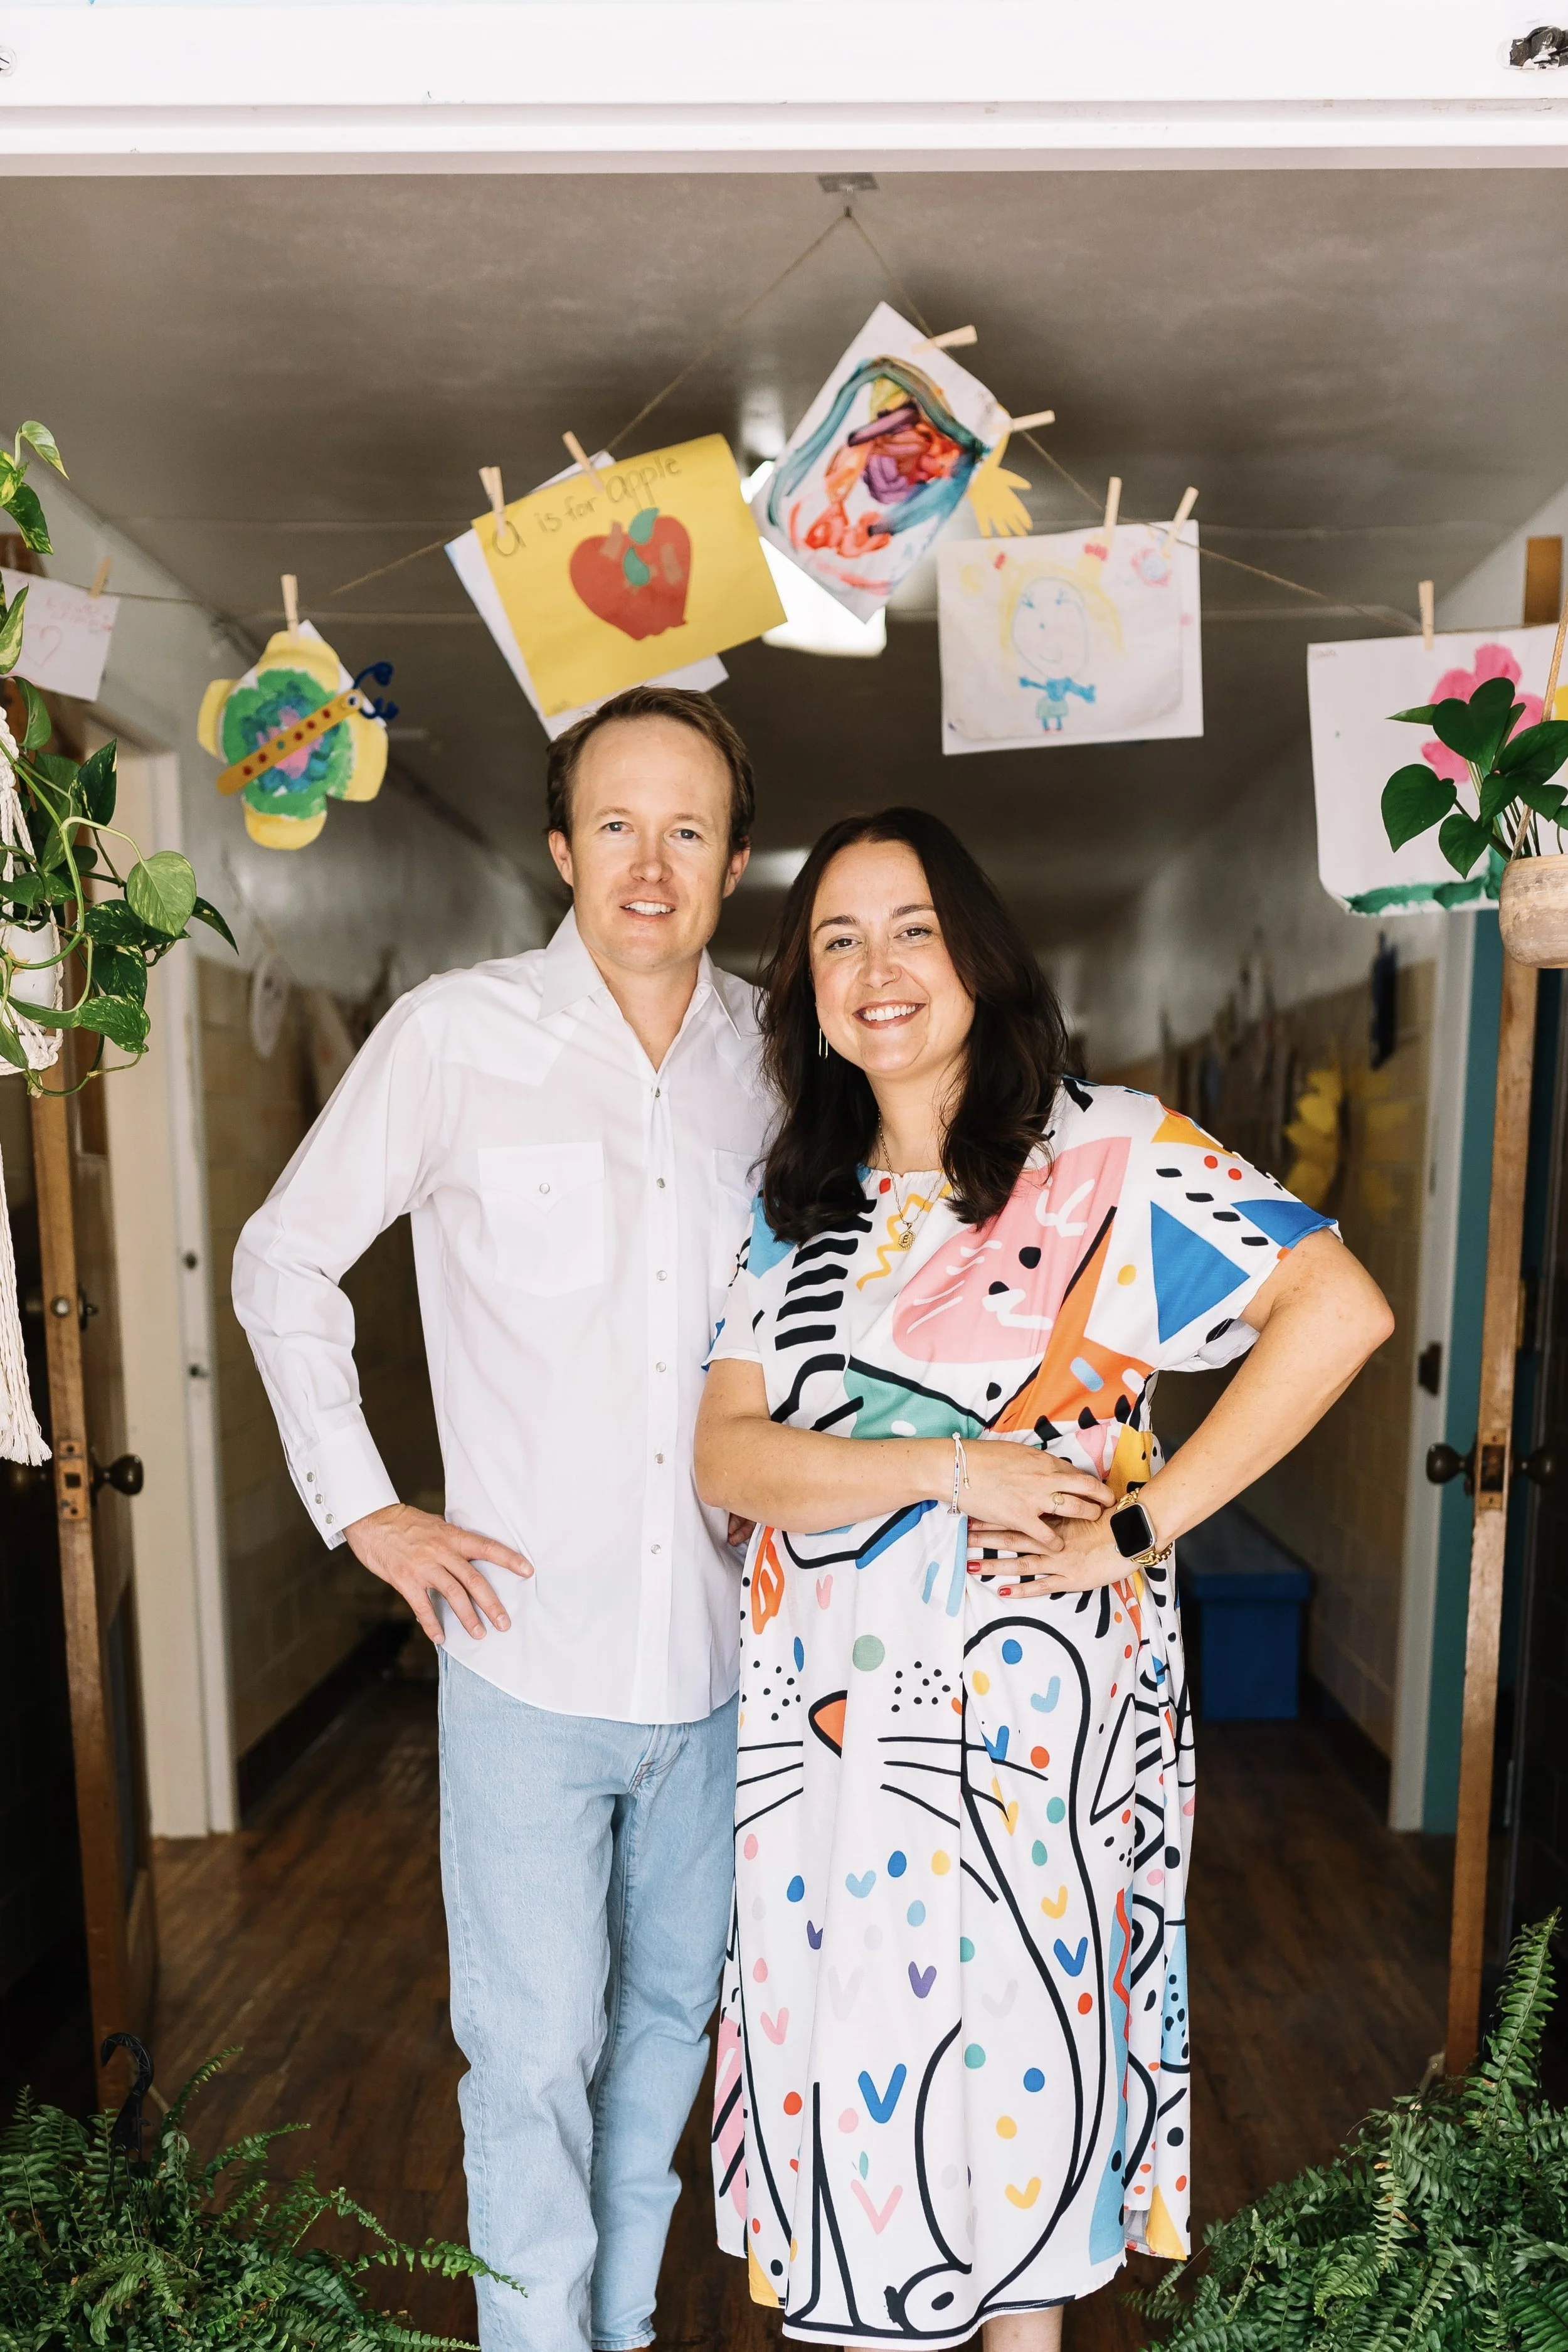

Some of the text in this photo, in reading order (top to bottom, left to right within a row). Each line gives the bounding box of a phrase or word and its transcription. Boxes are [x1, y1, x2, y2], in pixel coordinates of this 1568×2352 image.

[533, 512, 563, 533] is
[564, 495, 598, 521] for
[607, 456, 682, 512] apple
